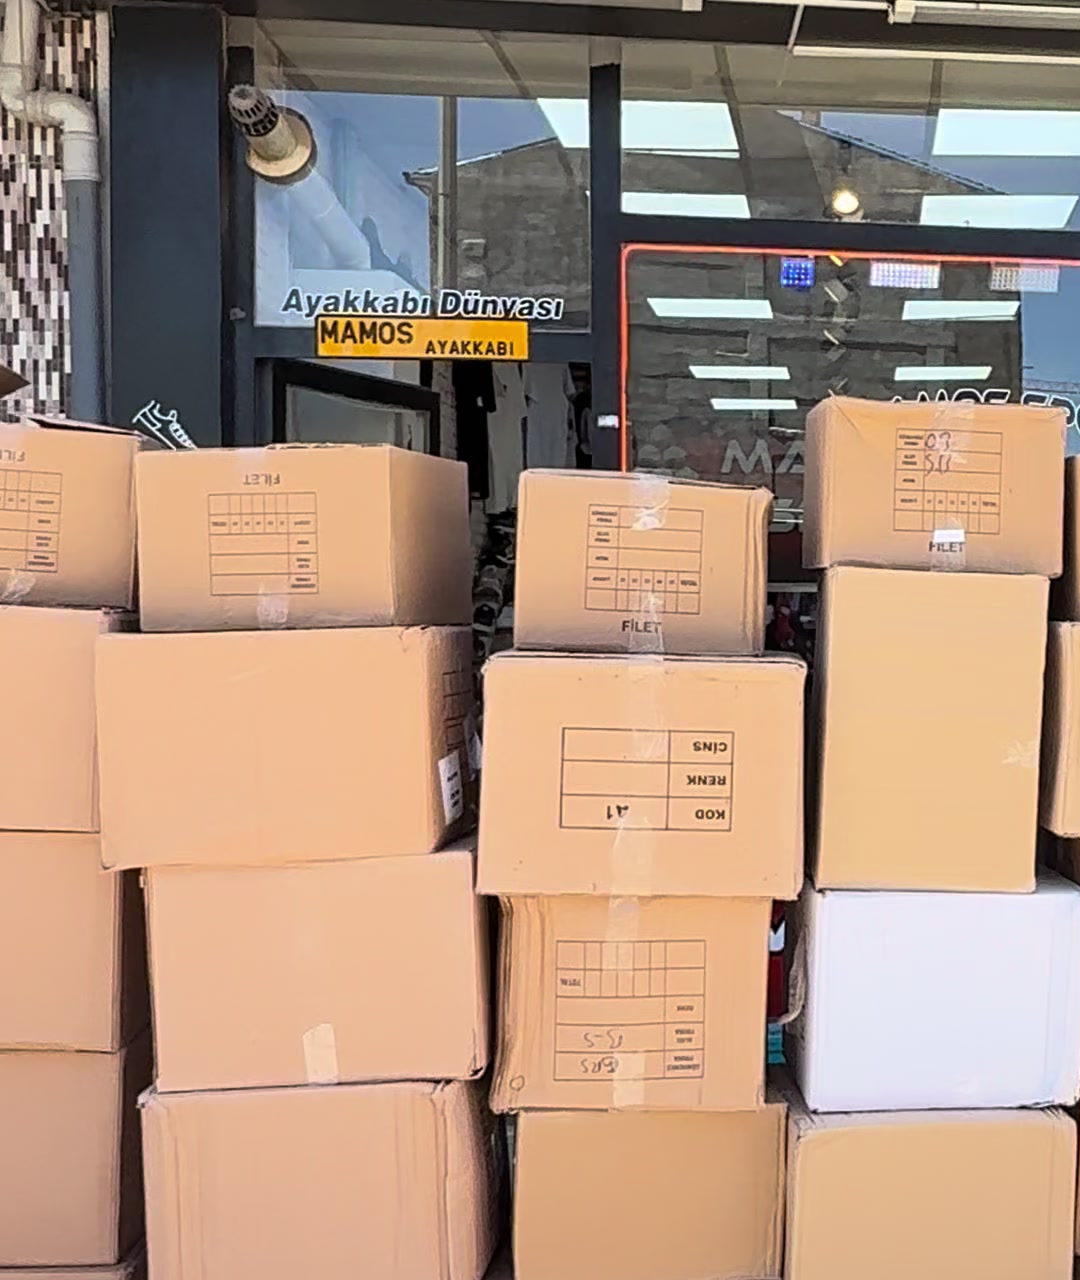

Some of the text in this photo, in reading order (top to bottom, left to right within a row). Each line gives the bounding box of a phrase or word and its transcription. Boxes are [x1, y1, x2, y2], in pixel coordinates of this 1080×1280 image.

[281, 288, 564, 319] Ayakkabı Dünyası
[425, 340, 514, 356] AYAKKABI
[686, 773, 727, 787] RENK
[694, 808, 726, 821] KOD
